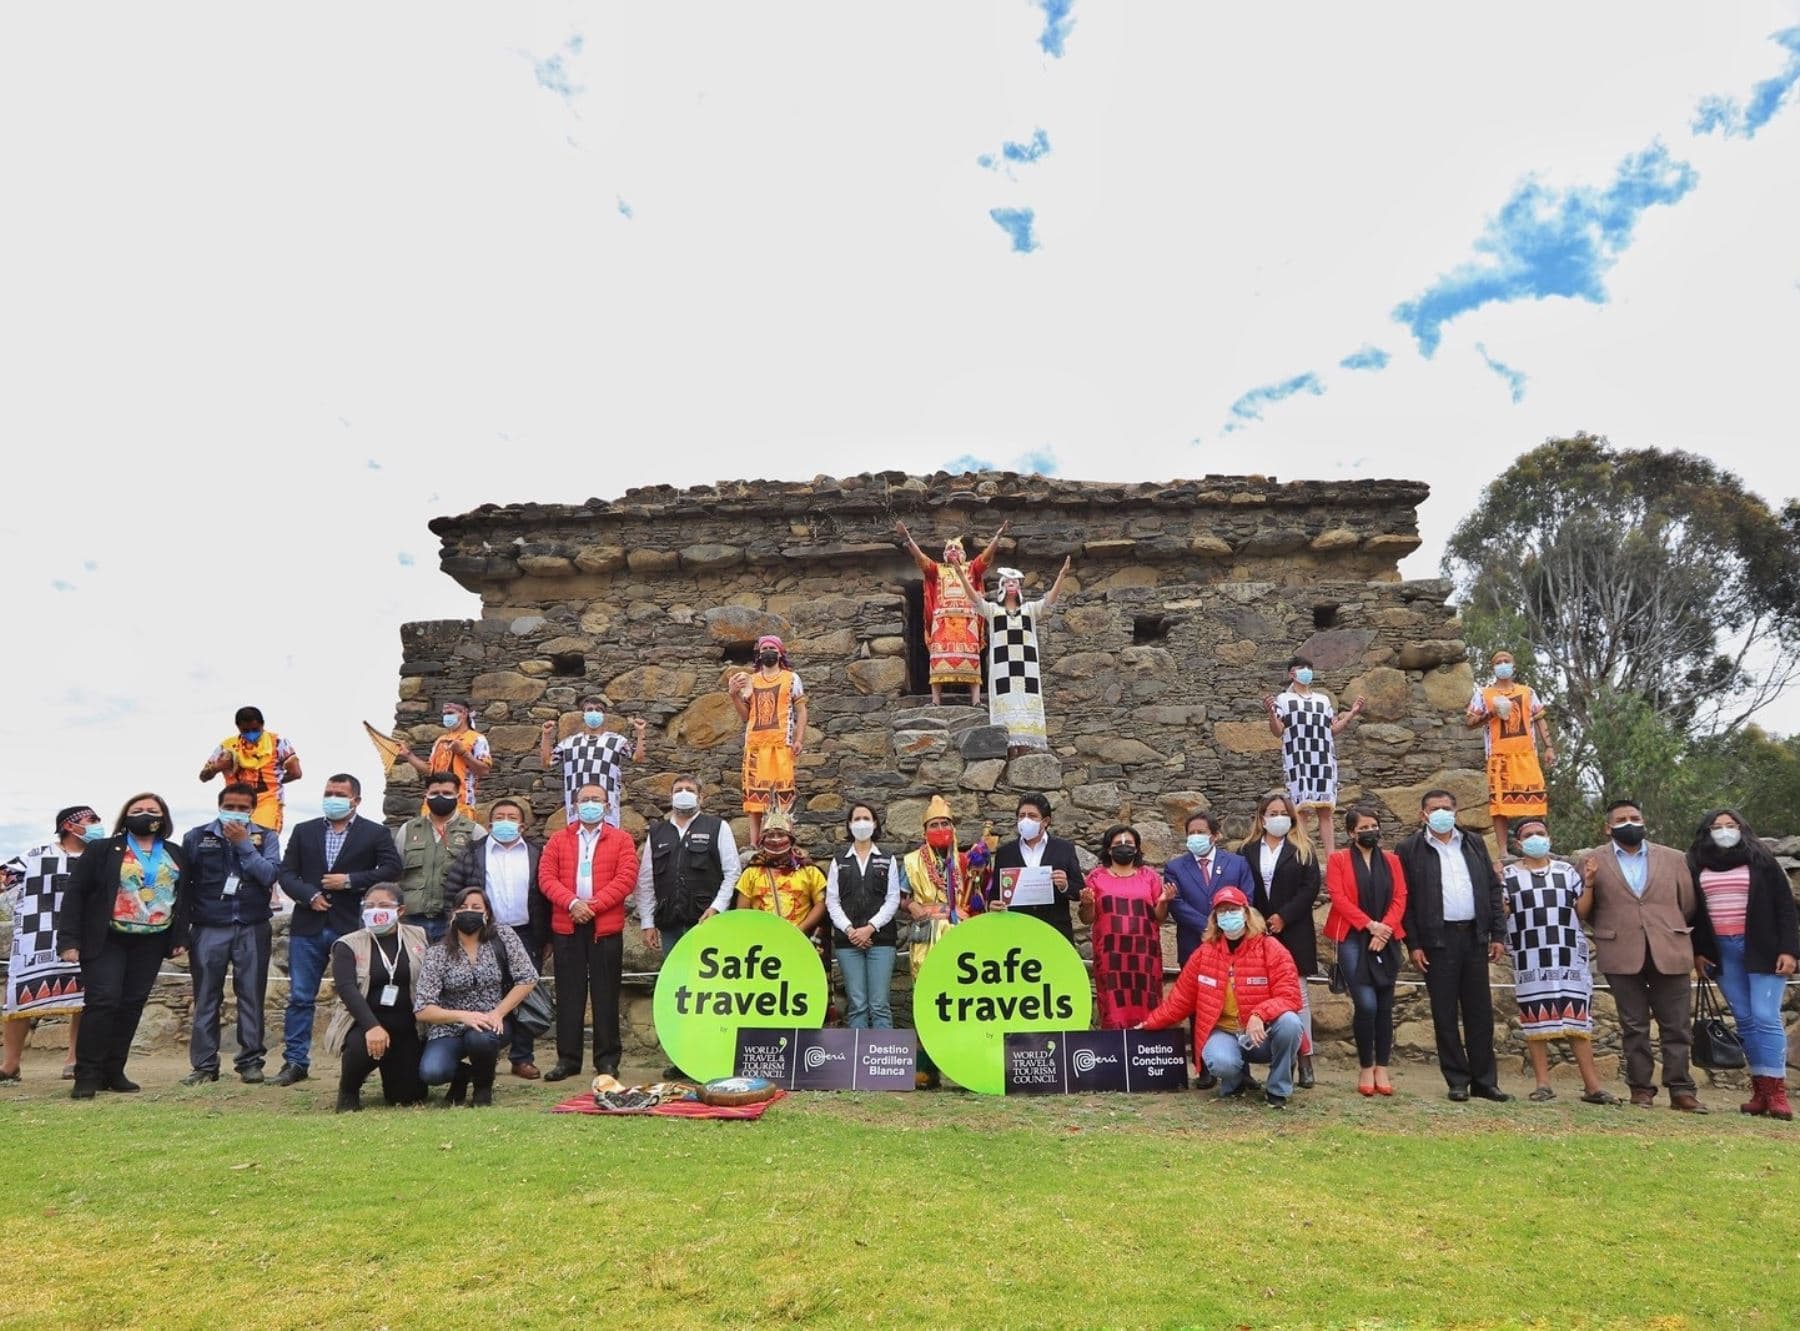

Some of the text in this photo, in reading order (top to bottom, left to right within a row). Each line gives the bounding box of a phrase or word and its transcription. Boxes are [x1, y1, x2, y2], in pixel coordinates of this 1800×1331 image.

[698, 945, 782, 980] Safe
[957, 948, 1042, 984] Safe
[675, 981, 808, 1016] travels
[935, 984, 1073, 1022] travels
[743, 1046, 779, 1054] WORLD
[869, 1045, 909, 1054] Destino
[1138, 1045, 1174, 1054] Destino
[743, 1054, 778, 1062] TRAVEL
[1013, 1051, 1048, 1059] WORLD
[862, 1055, 913, 1065] Cordillera
[1013, 1059, 1049, 1067] TRAVEL
[1132, 1056, 1184, 1066] Conchucos
[742, 1062, 785, 1070] TOURISM
[741, 1070, 785, 1079] COUNCIL
[869, 1067, 905, 1076] Blanca
[1013, 1067, 1057, 1076] TOURISM
[1147, 1067, 1165, 1076] Sur
[1013, 1075, 1058, 1084] COUNCIL
